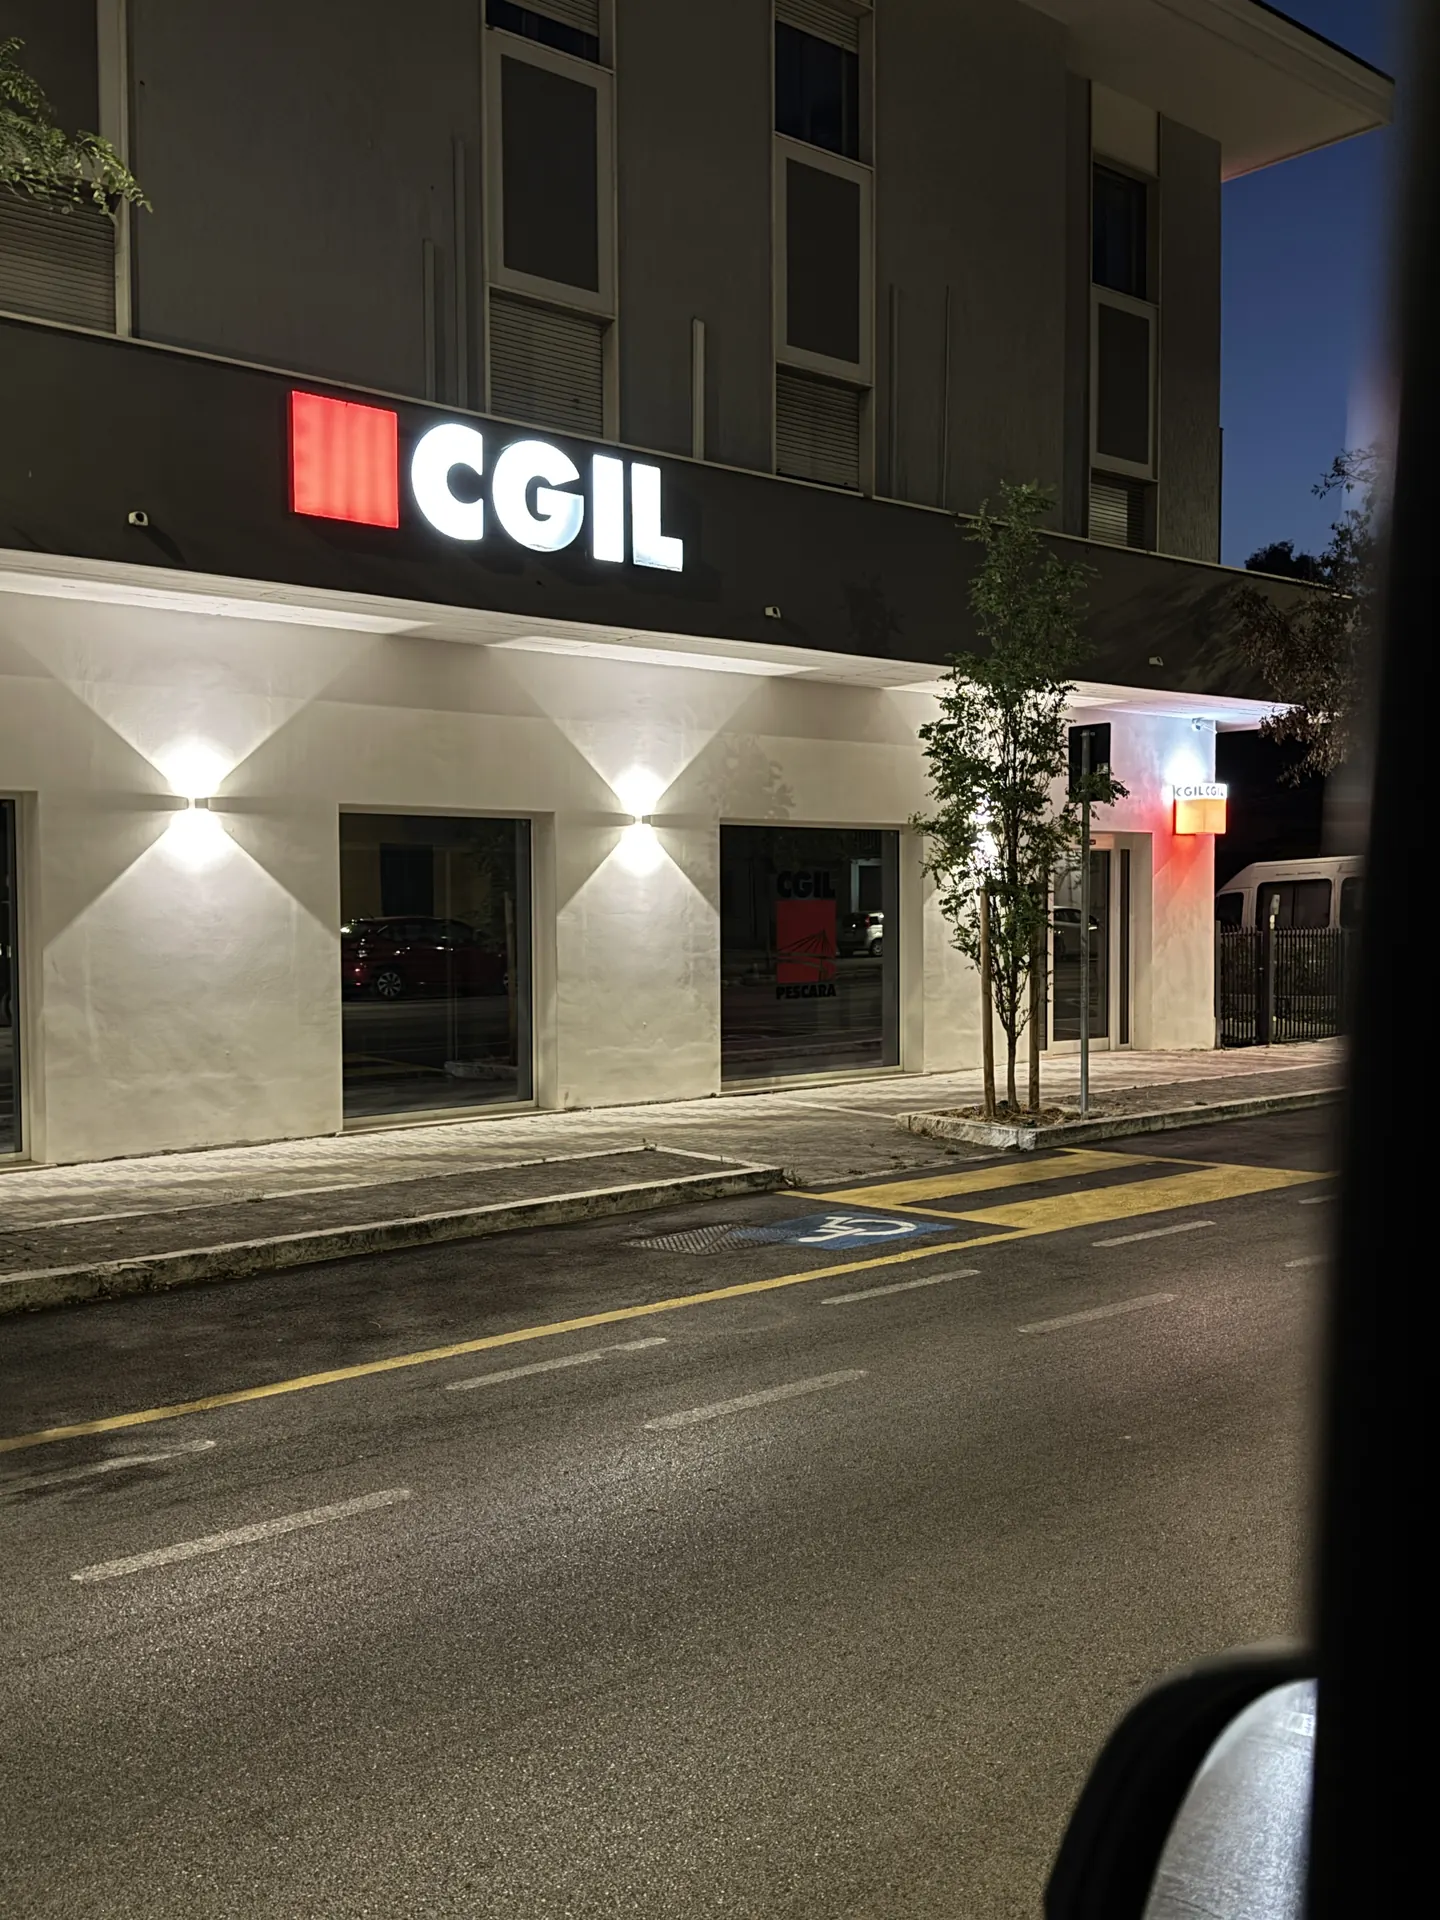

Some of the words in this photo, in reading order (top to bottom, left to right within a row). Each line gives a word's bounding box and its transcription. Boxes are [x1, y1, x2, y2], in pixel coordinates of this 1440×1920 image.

[411, 423, 683, 572] CGIL
[1176, 786, 1203, 796] CGIL
[777, 871, 835, 898] CGIL
[776, 984, 836, 999] PESCARA
